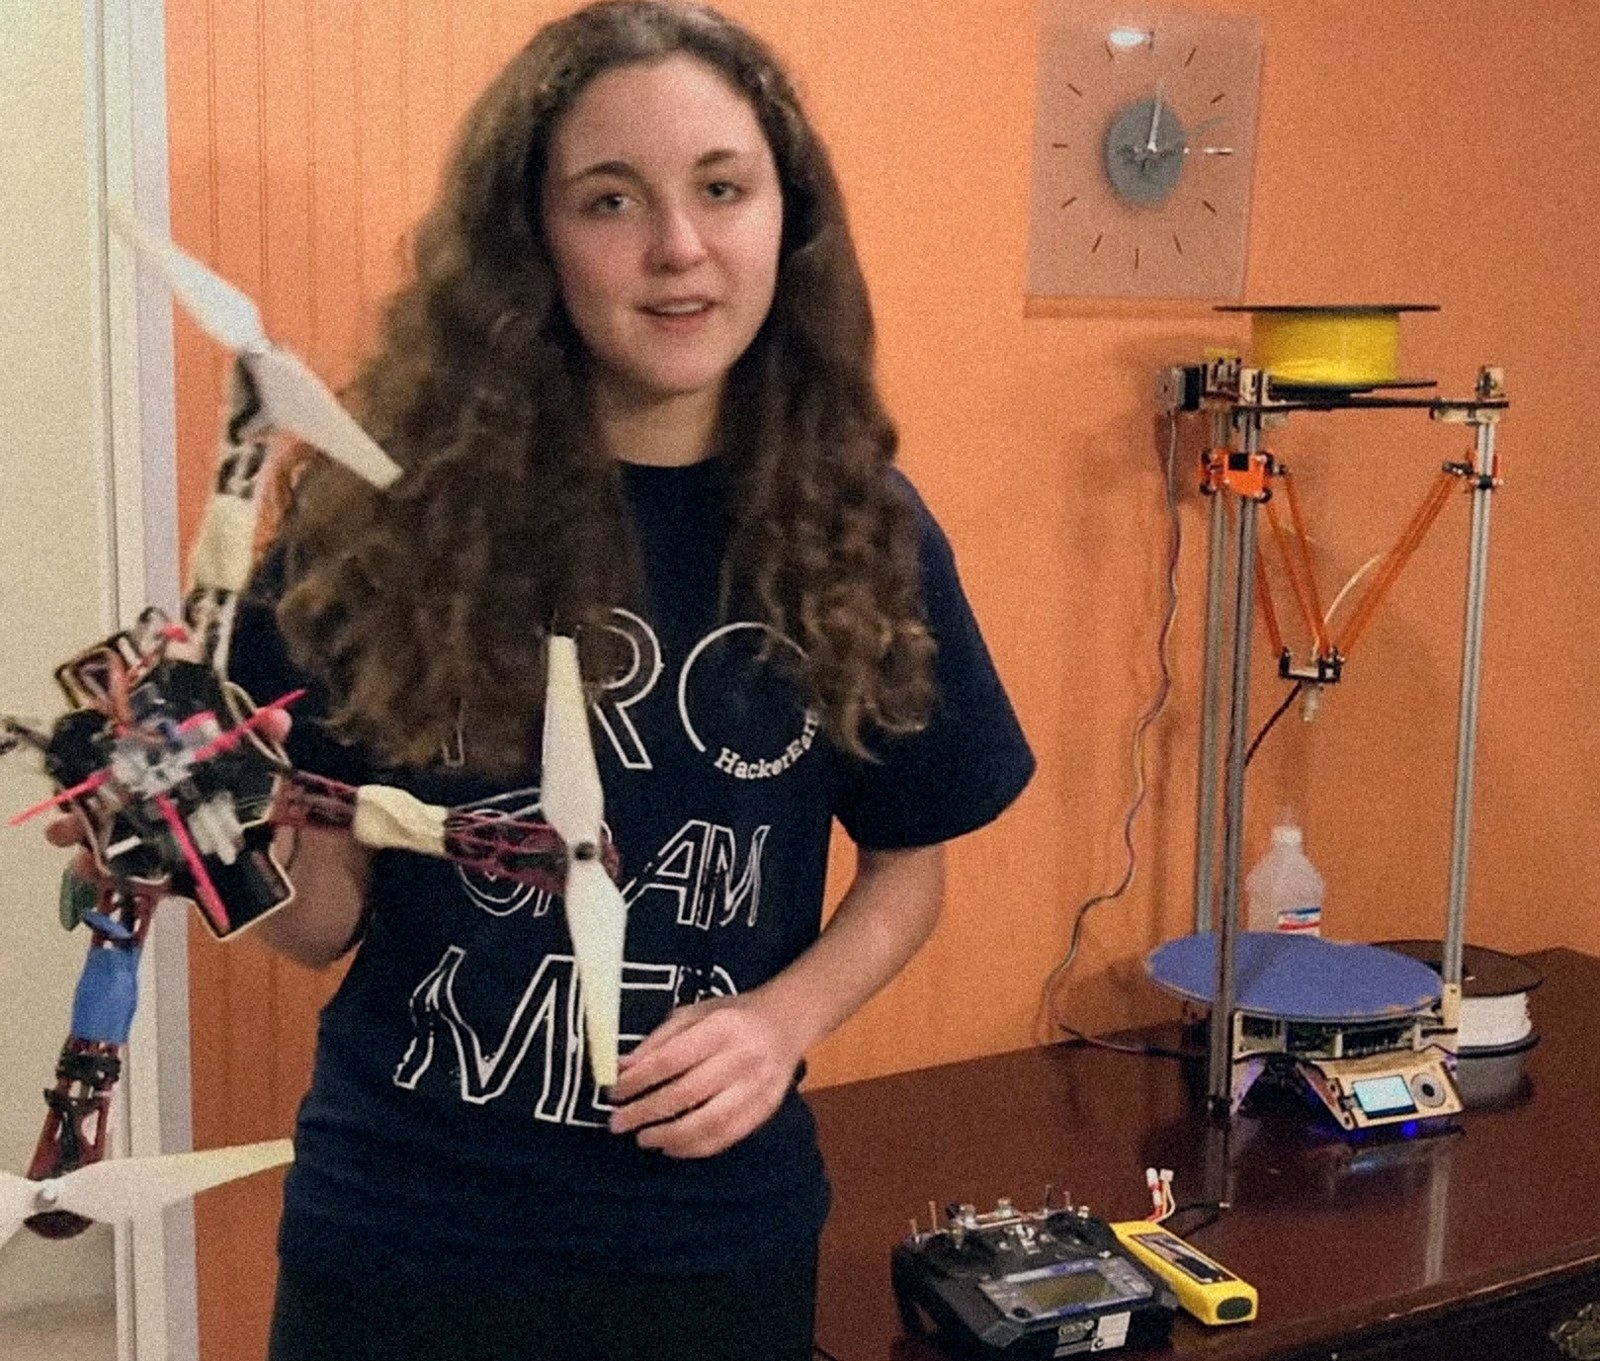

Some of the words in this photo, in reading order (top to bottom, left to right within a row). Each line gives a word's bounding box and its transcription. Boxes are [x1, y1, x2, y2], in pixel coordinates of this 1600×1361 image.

[444, 607, 812, 770] RO
[714, 708, 820, 780] HackerEar
[458, 810, 770, 930] AM
[394, 945, 740, 1127] ME
